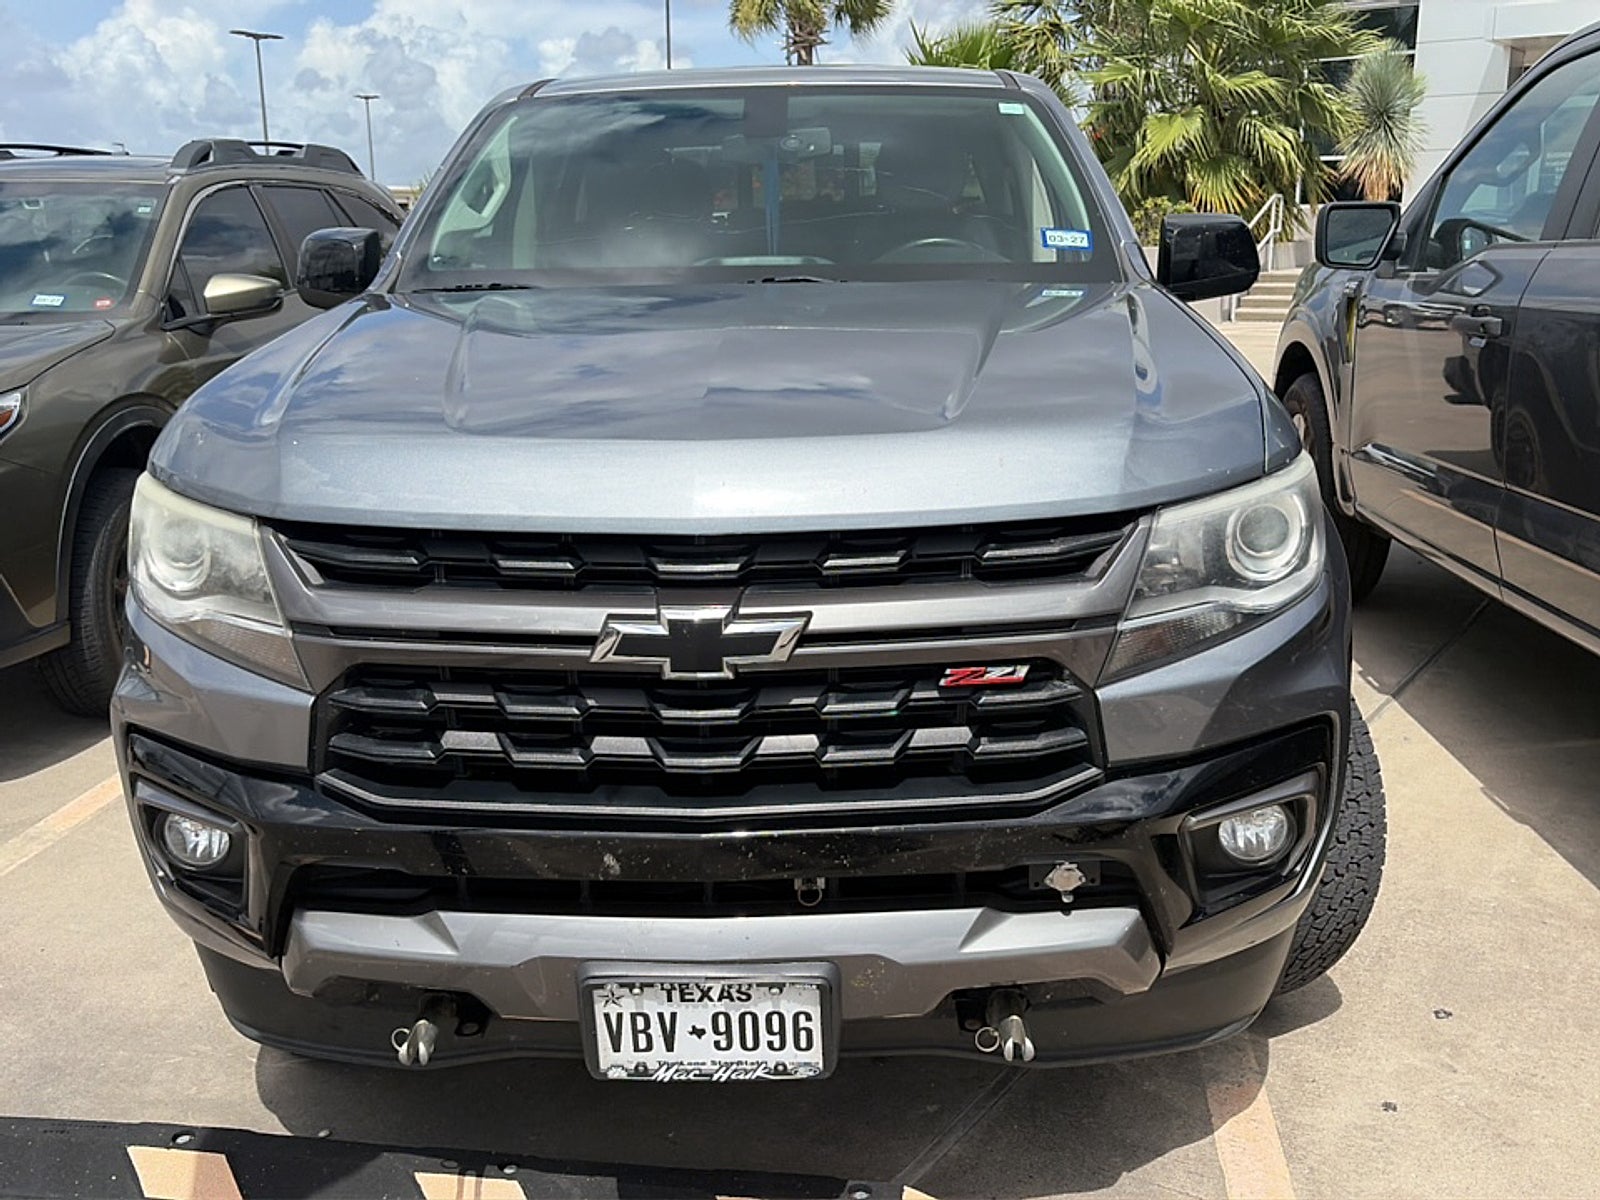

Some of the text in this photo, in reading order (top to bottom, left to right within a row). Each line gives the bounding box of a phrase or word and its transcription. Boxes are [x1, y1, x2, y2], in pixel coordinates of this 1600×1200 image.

[1048, 234, 1085, 244] 03-27
[660, 983, 753, 1003] TEXAS
[603, 1010, 815, 1053] VBV 9096
[651, 1064, 707, 1082] Mac
[711, 1063, 775, 1082] Haik
